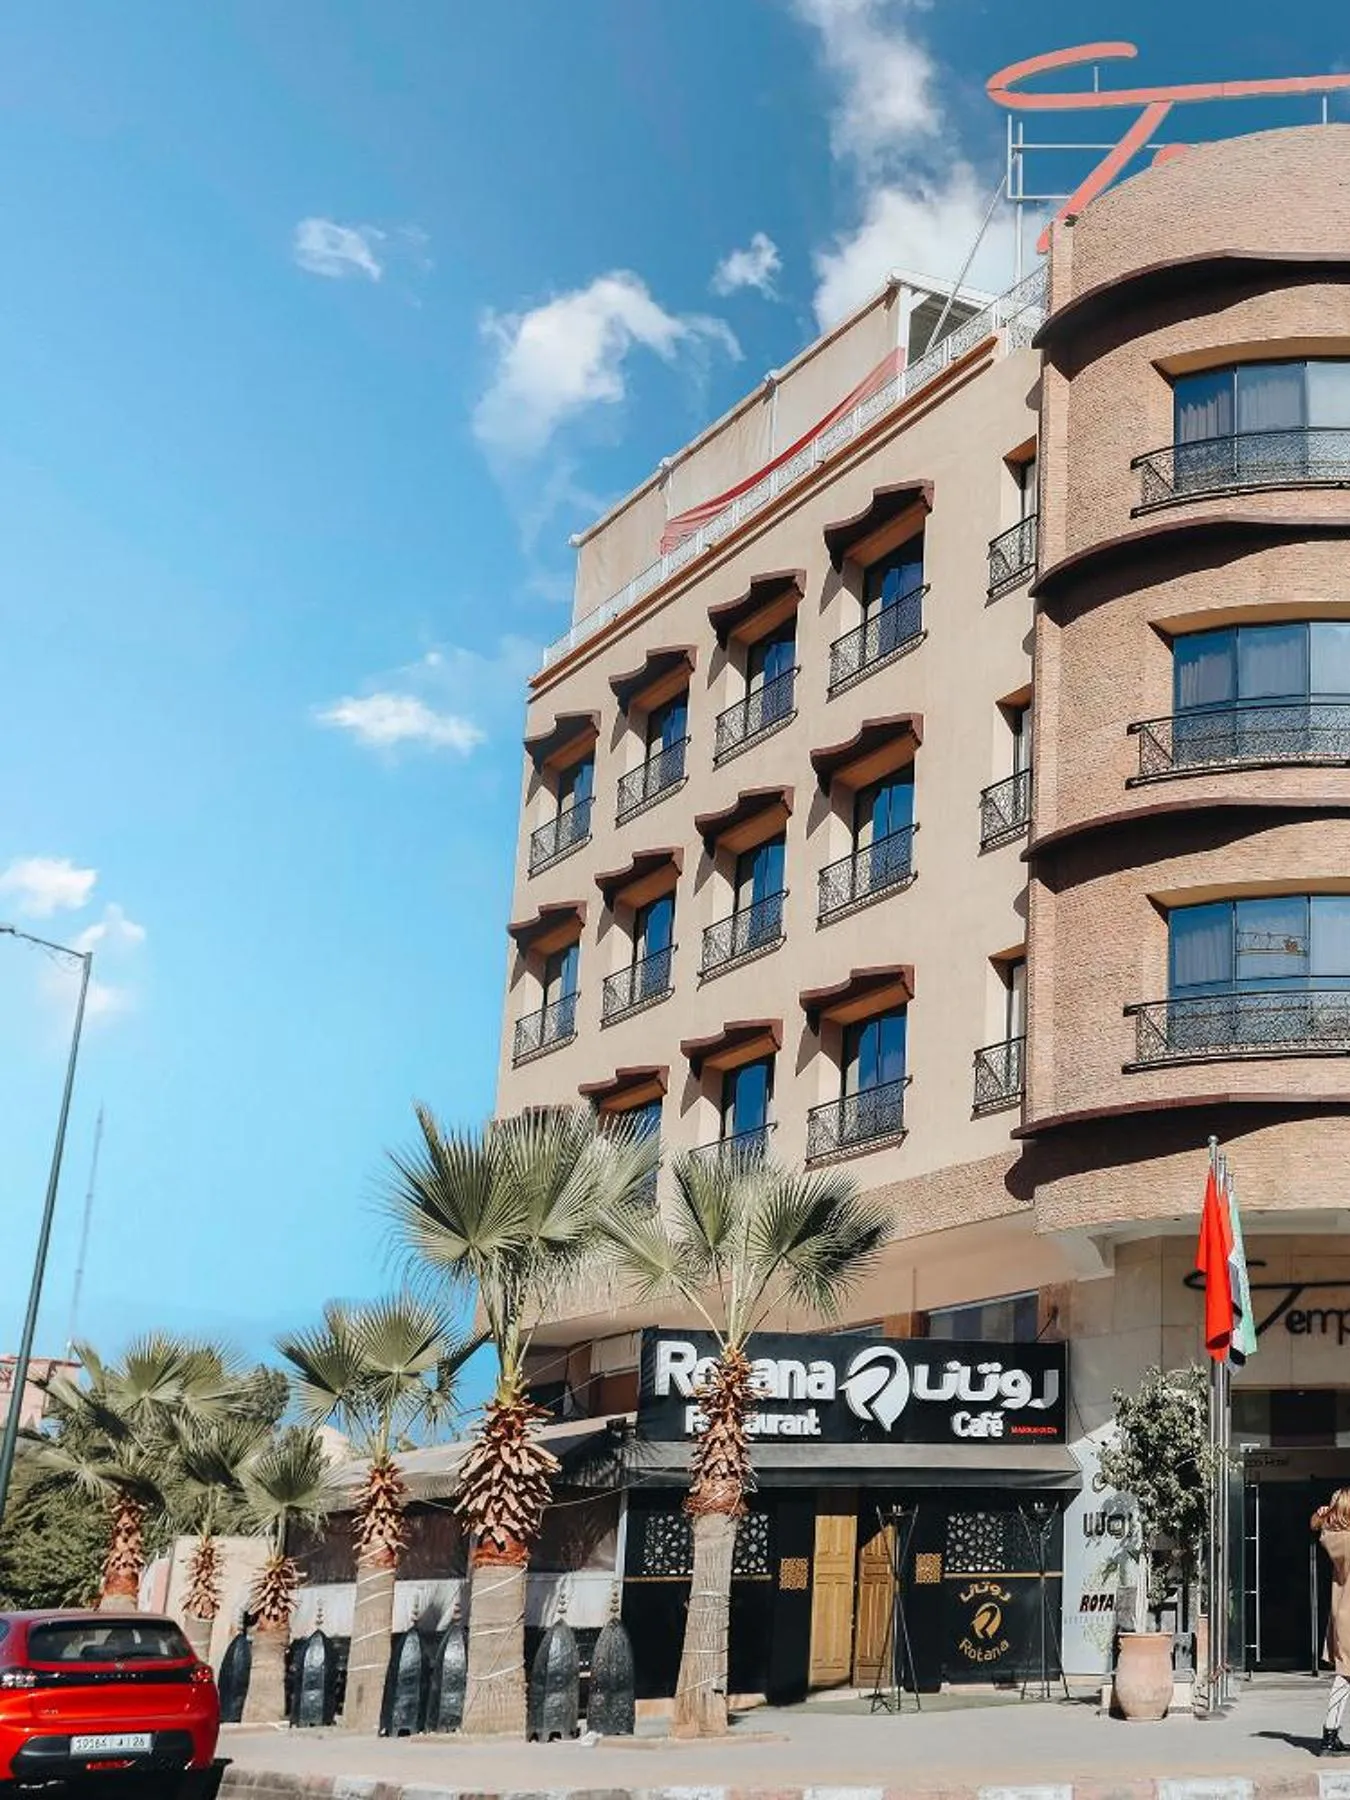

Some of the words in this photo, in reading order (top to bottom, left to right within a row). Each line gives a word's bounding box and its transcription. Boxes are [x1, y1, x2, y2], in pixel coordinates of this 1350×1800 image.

[654, 1340, 836, 1400] Roana
[685, 1405, 822, 1436] Raurant
[952, 1410, 1005, 1438] Café
[1079, 1594, 1115, 1612] ROTA
[958, 1638, 1010, 1663] Rotana
